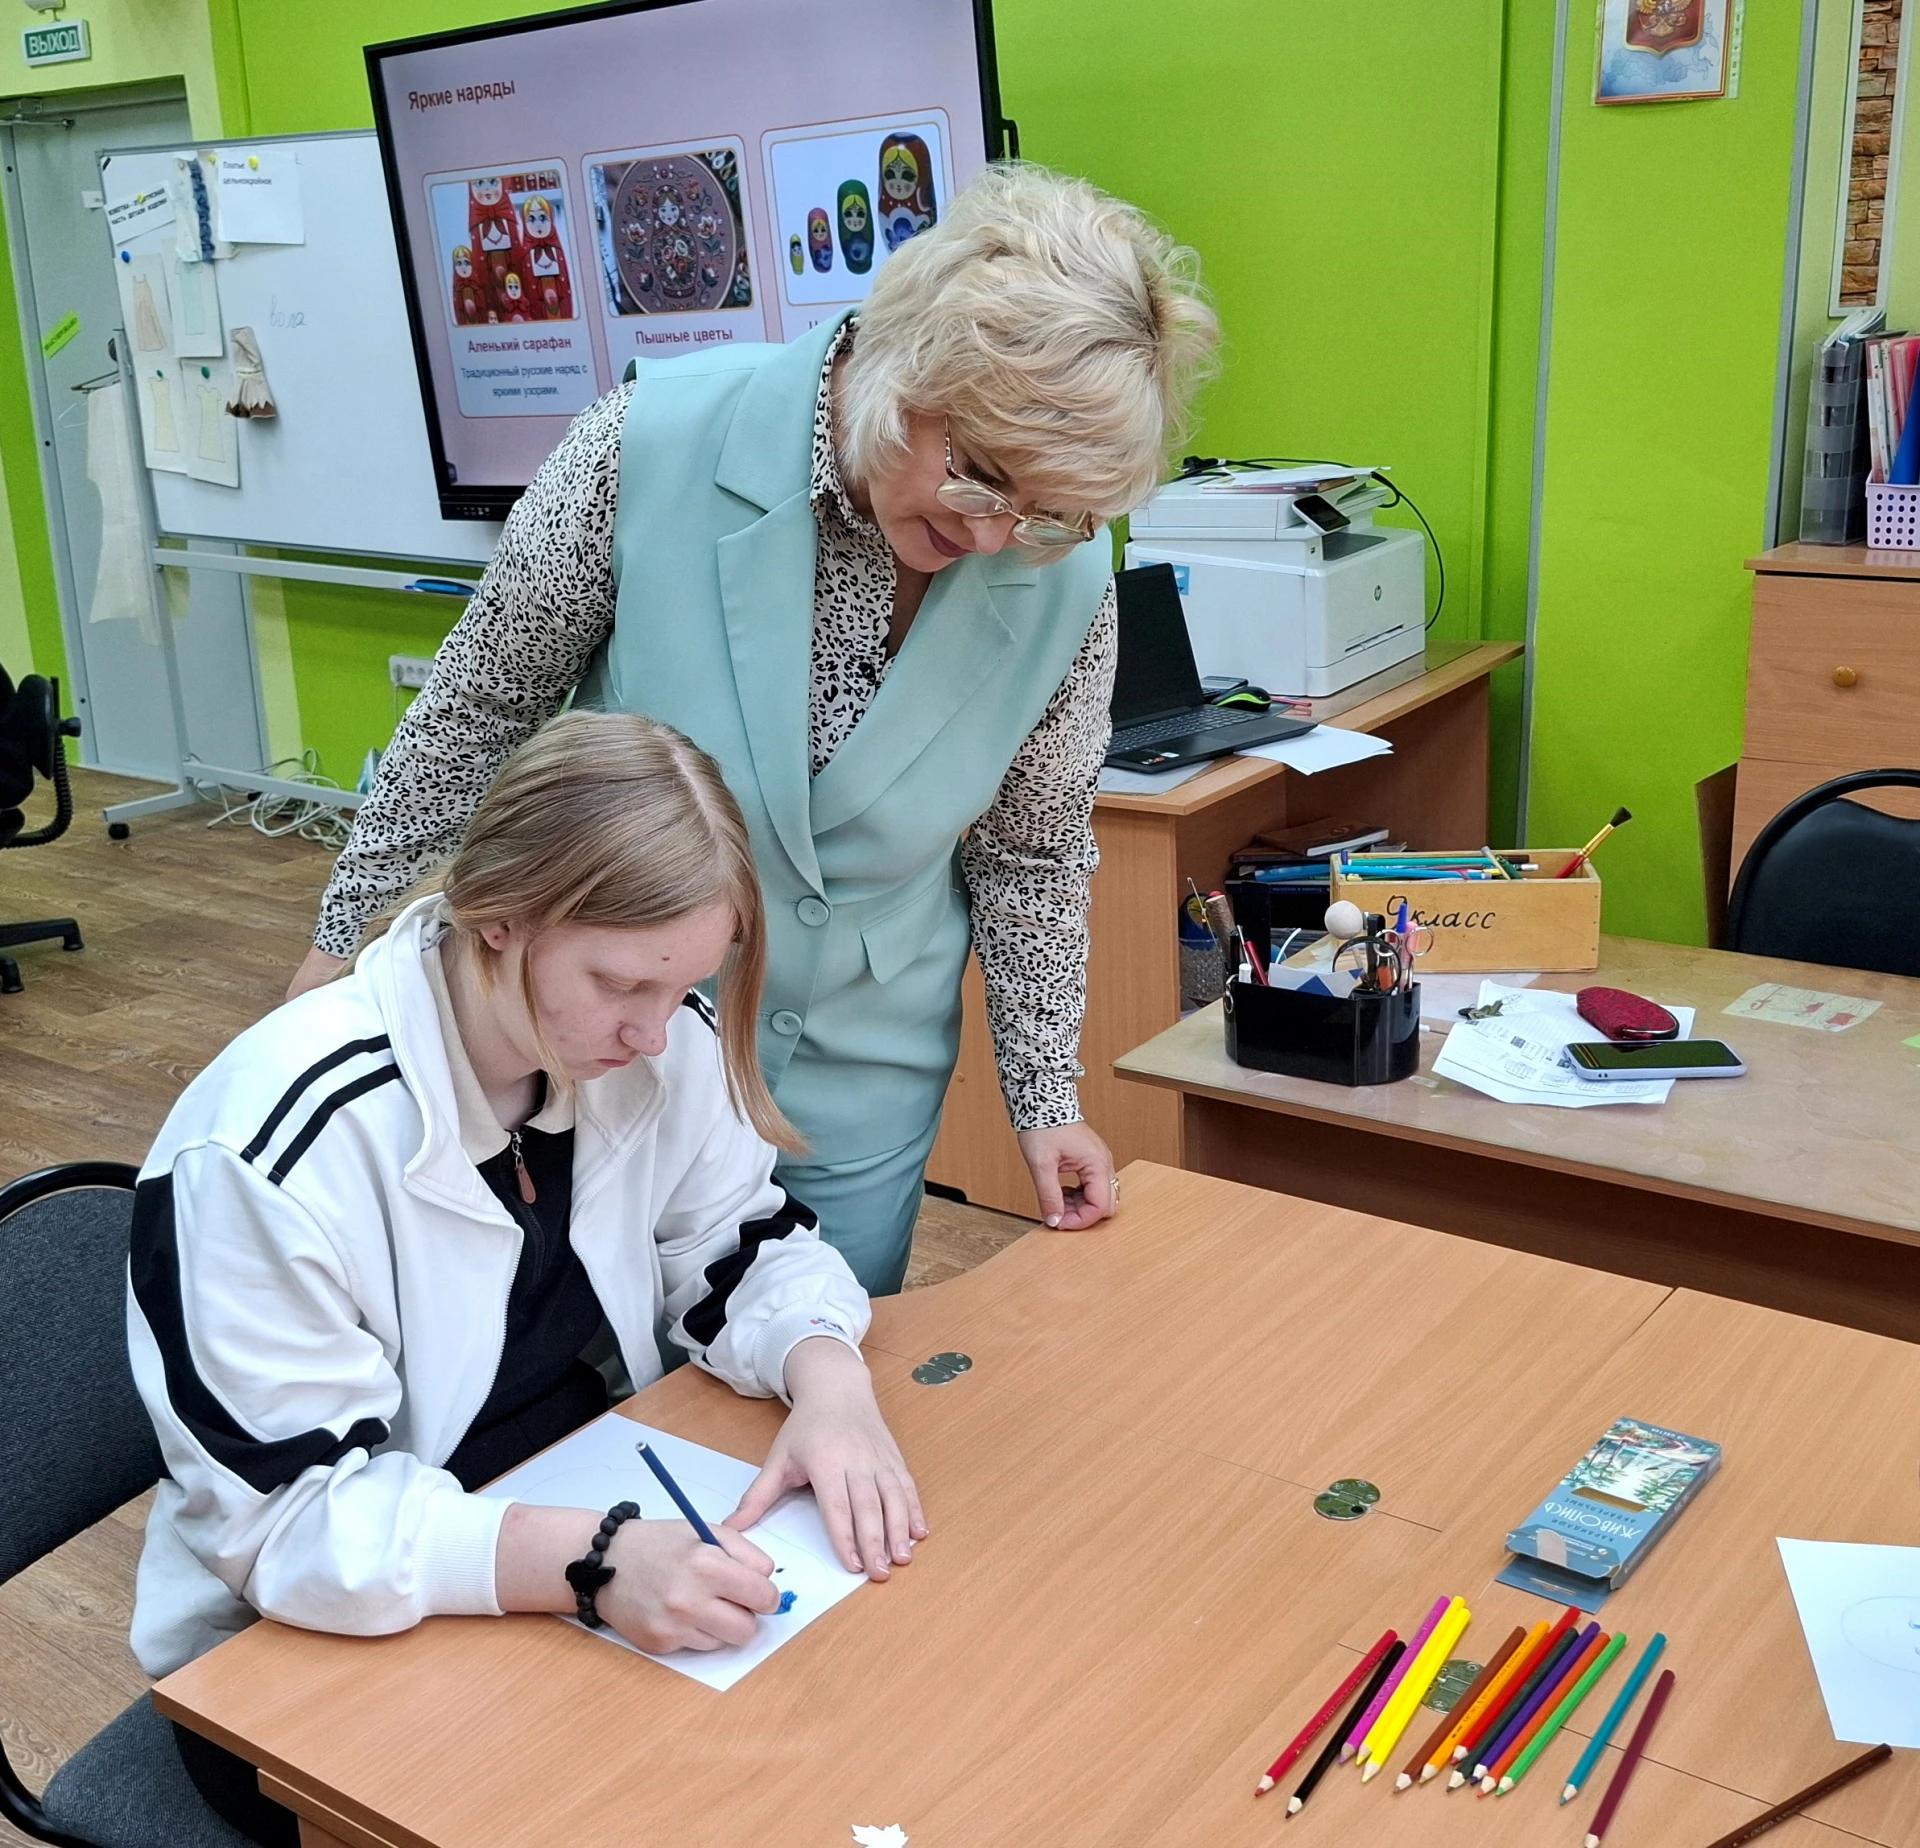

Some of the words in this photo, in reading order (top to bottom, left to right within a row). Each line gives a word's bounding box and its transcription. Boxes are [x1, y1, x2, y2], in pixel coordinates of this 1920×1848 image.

[28, 25, 79, 56] ВЫХОД
[408, 88, 453, 111] Яркие
[456, 78, 516, 106] наряды
[468, 338, 521, 354] Аленький
[523, 336, 572, 353] сарафан
[635, 330, 690, 345] Пышные
[693, 327, 733, 344] цветы
[461, 366, 520, 380] Традиционный
[555, 365, 580, 376] наряд
[582, 364, 588, 374] с
[492, 387, 522, 398] яркими
[1409, 905, 1497, 930] класс
[1544, 1501, 1644, 1540] ЖИВОПИСЬ
[1563, 1497, 1637, 1524] АКВАРЕЛЬНЫЕ
[1550, 1519, 1614, 1543] КАРАНДАШИ
